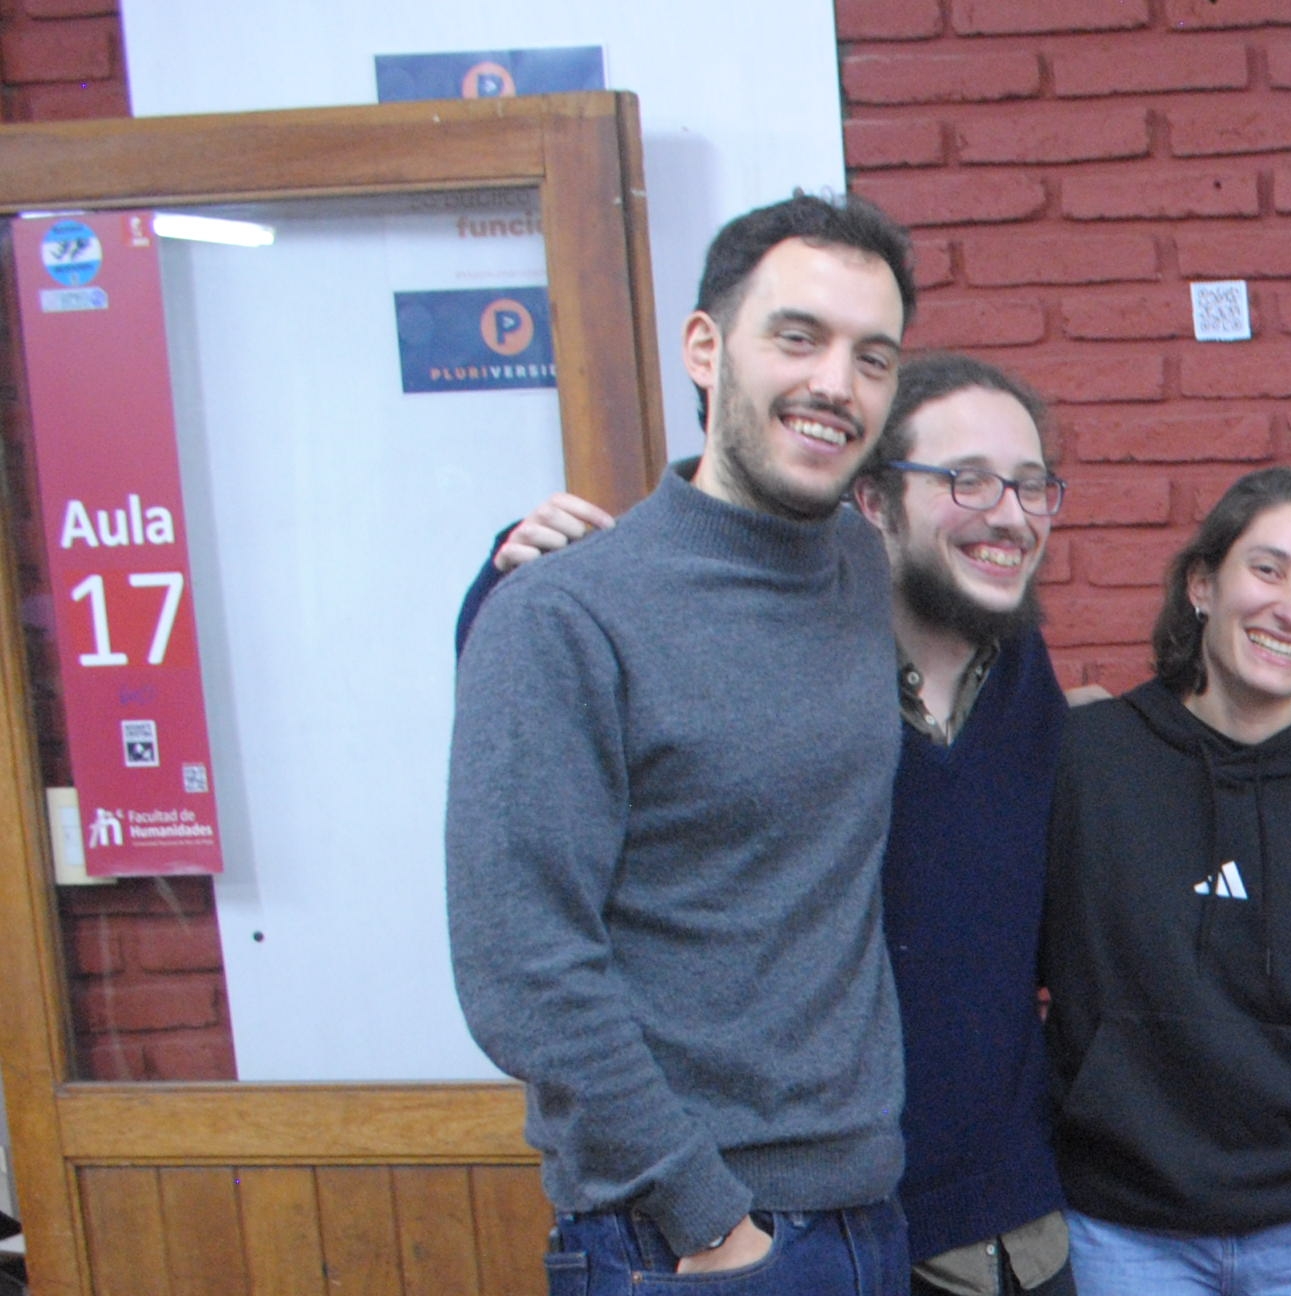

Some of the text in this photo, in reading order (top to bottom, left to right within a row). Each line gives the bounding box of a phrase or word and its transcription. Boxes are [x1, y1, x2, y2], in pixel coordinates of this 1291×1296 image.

[494, 309, 522, 345] P
[60, 493, 175, 549] Aula
[71, 571, 184, 667] 17
[128, 808, 196, 823] Facultad de
[130, 822, 214, 838] Humanidades
